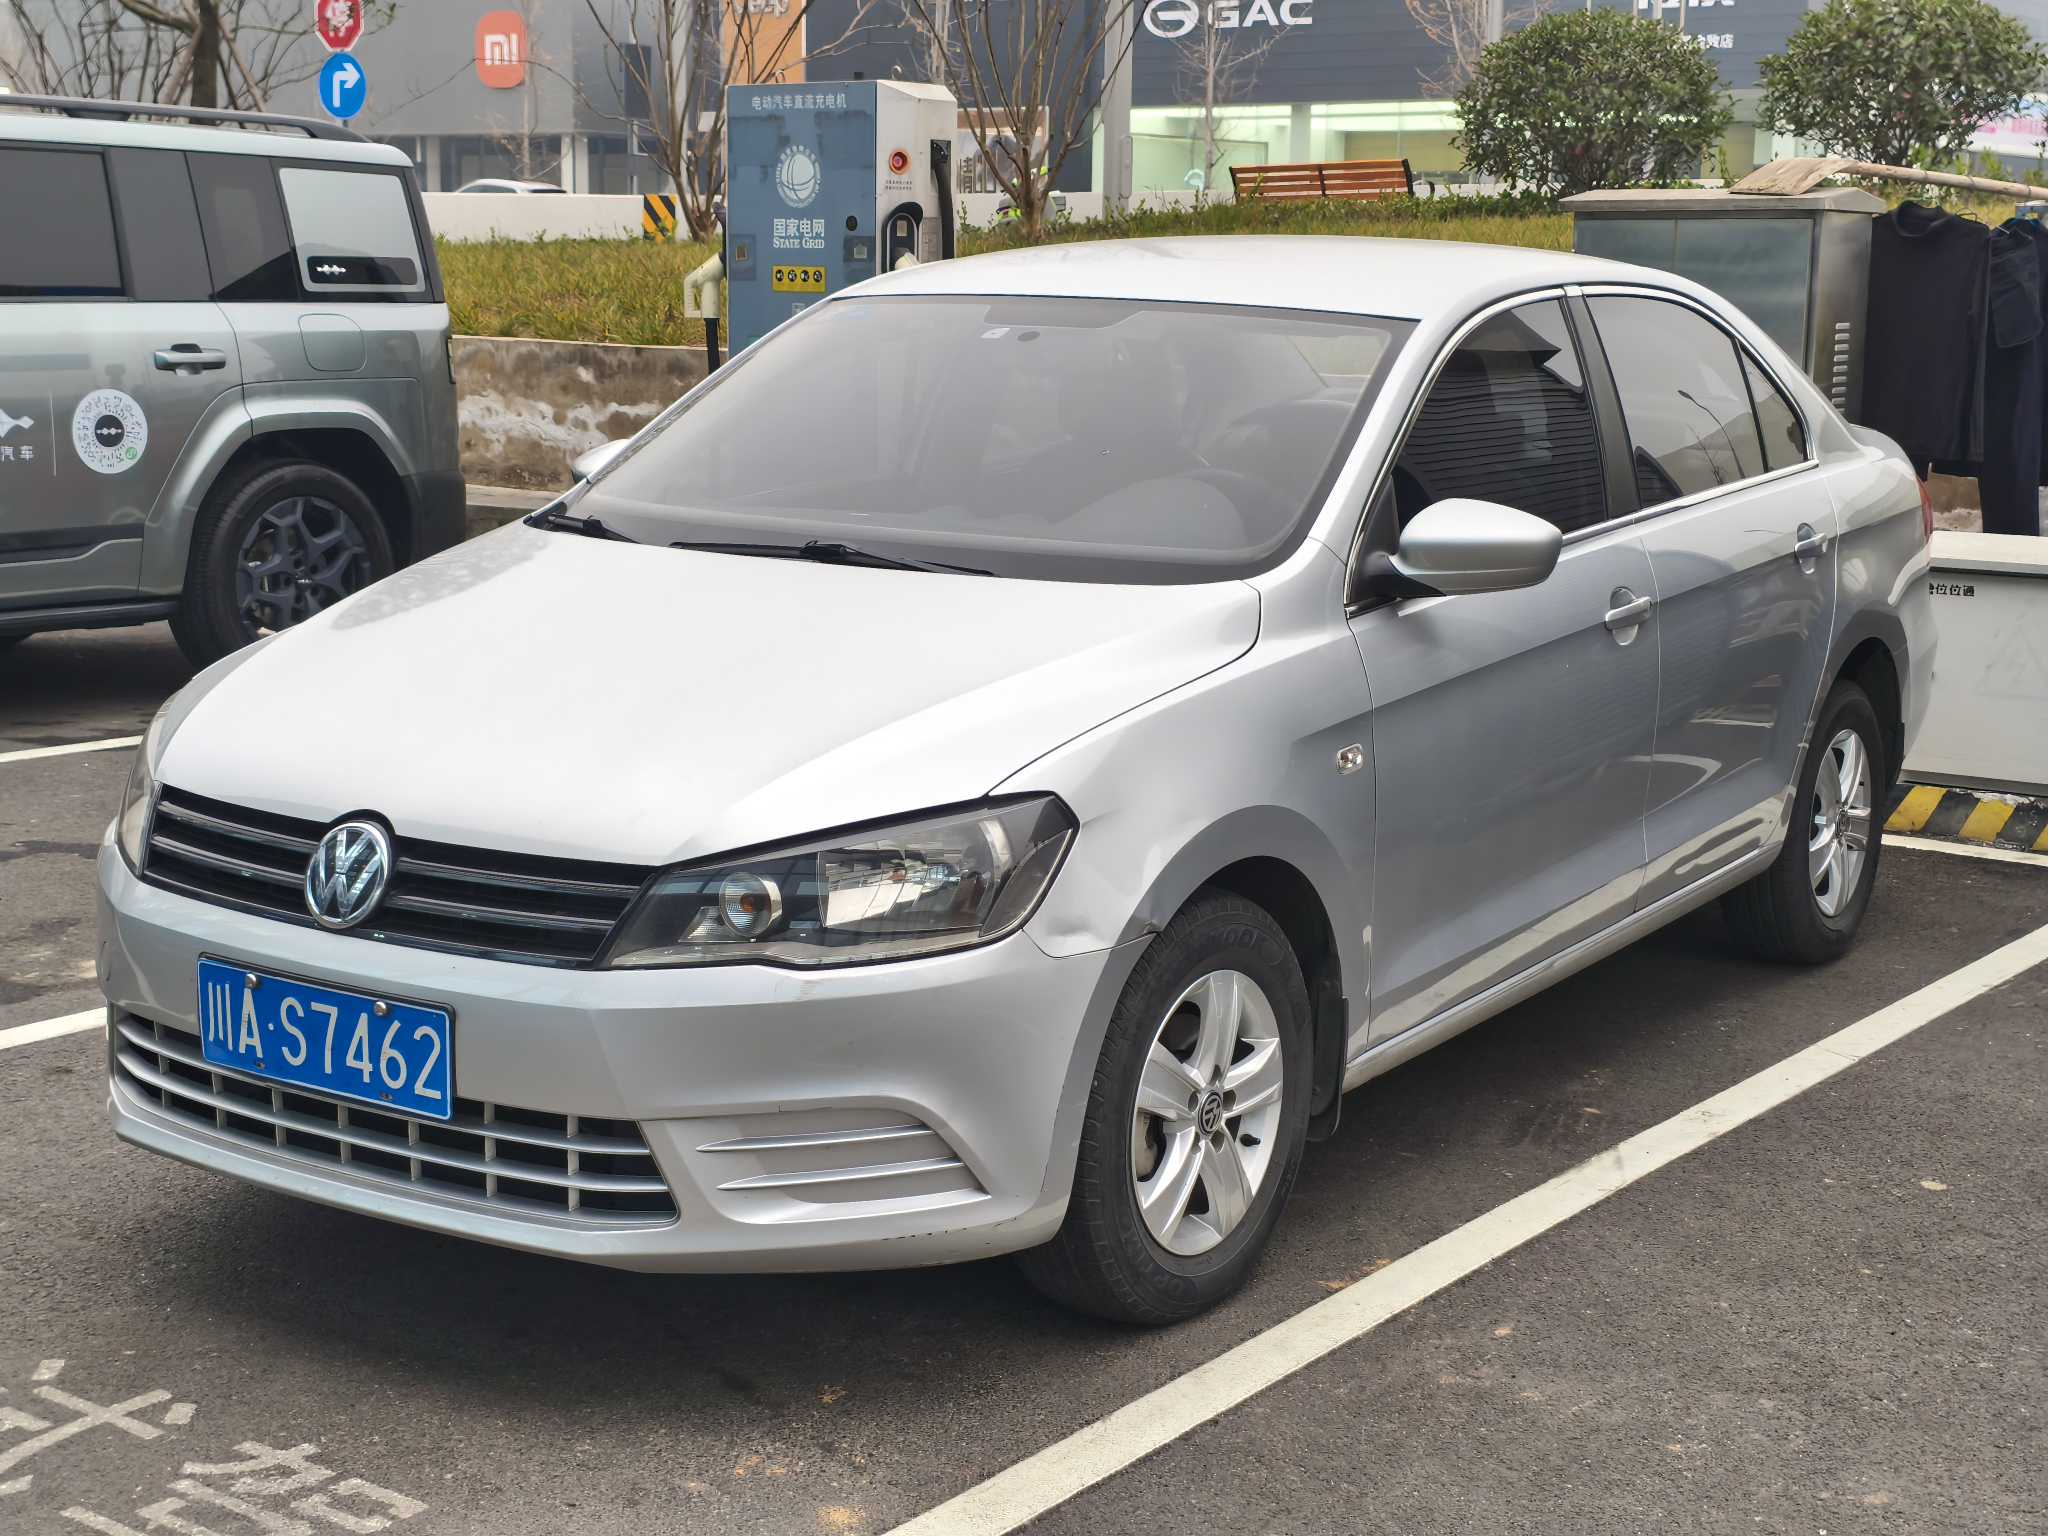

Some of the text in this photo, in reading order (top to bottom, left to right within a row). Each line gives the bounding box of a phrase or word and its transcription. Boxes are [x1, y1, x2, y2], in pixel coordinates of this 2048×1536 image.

[1207, 0, 1313, 28] GAC
[773, 217, 825, 237] 国家电网
